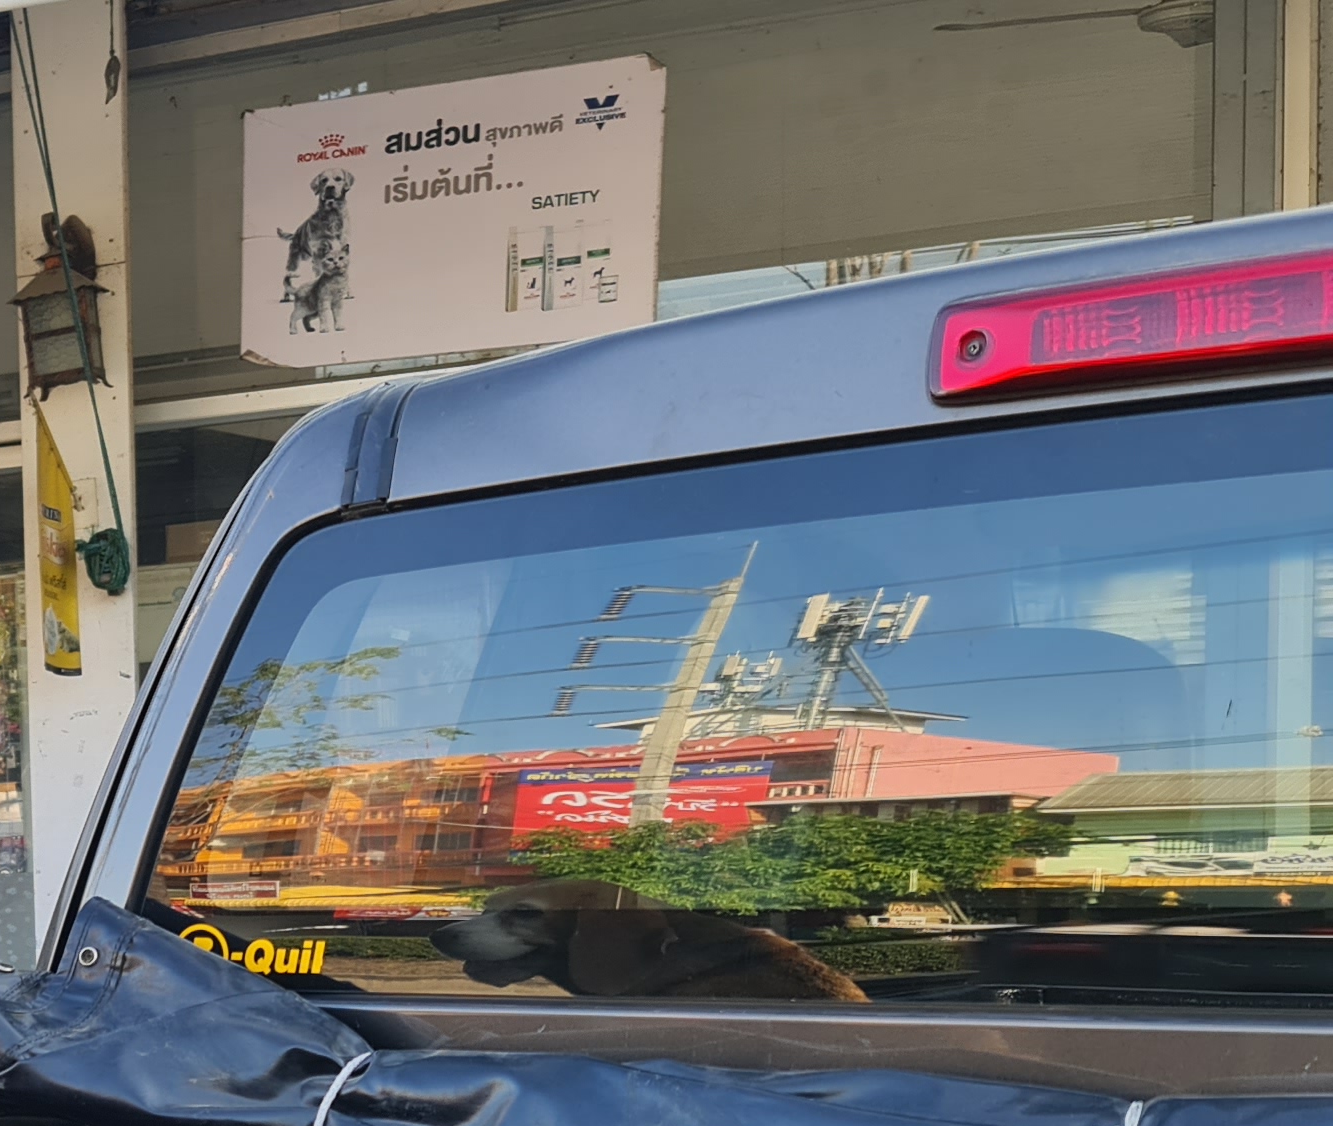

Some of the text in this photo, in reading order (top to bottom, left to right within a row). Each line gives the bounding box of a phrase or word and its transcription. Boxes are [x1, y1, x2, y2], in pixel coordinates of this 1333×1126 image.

[575, 112, 627, 125] EXCLUSIVE
[384, 114, 565, 156] สมส่วน สุขภาพดี
[297, 145, 366, 163] ROYAL CANIN
[531, 189, 600, 210] SATIETY
